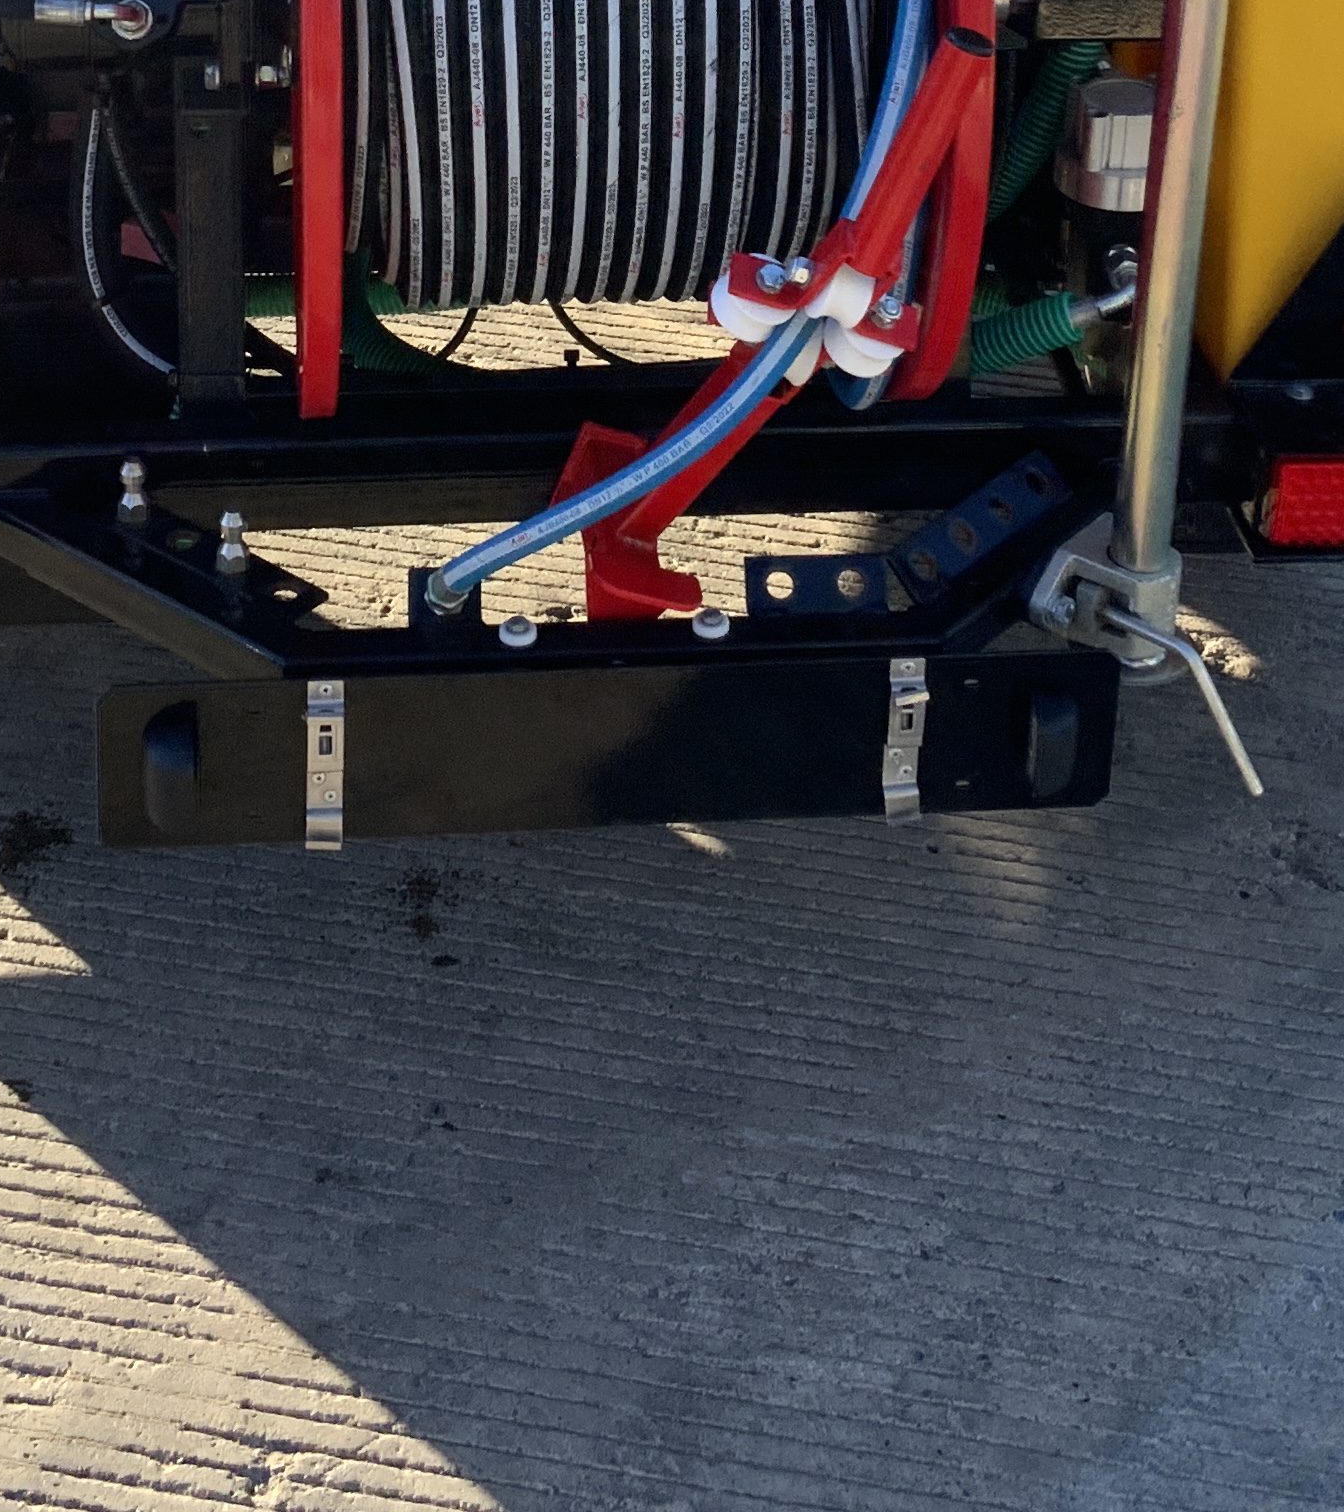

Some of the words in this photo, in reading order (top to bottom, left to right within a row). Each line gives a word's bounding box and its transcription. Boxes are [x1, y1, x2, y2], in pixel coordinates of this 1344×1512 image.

[469, 4, 479, 33] DN12
[741, 9, 751, 51] Q3/2023
[436, 15, 445, 59] Q3/2023
[675, 17, 684, 46] DN12
[577, 34, 586, 82] AJ440-08
[543, 84, 553, 98] BS
[543, 106, 552, 129] BAR
[641, 99, 650, 115] BS
[543, 131, 552, 148] 440
[641, 122, 650, 145] BAR
[84, 231, 94, 250] BAR
[671, 440, 692, 459] BAR
